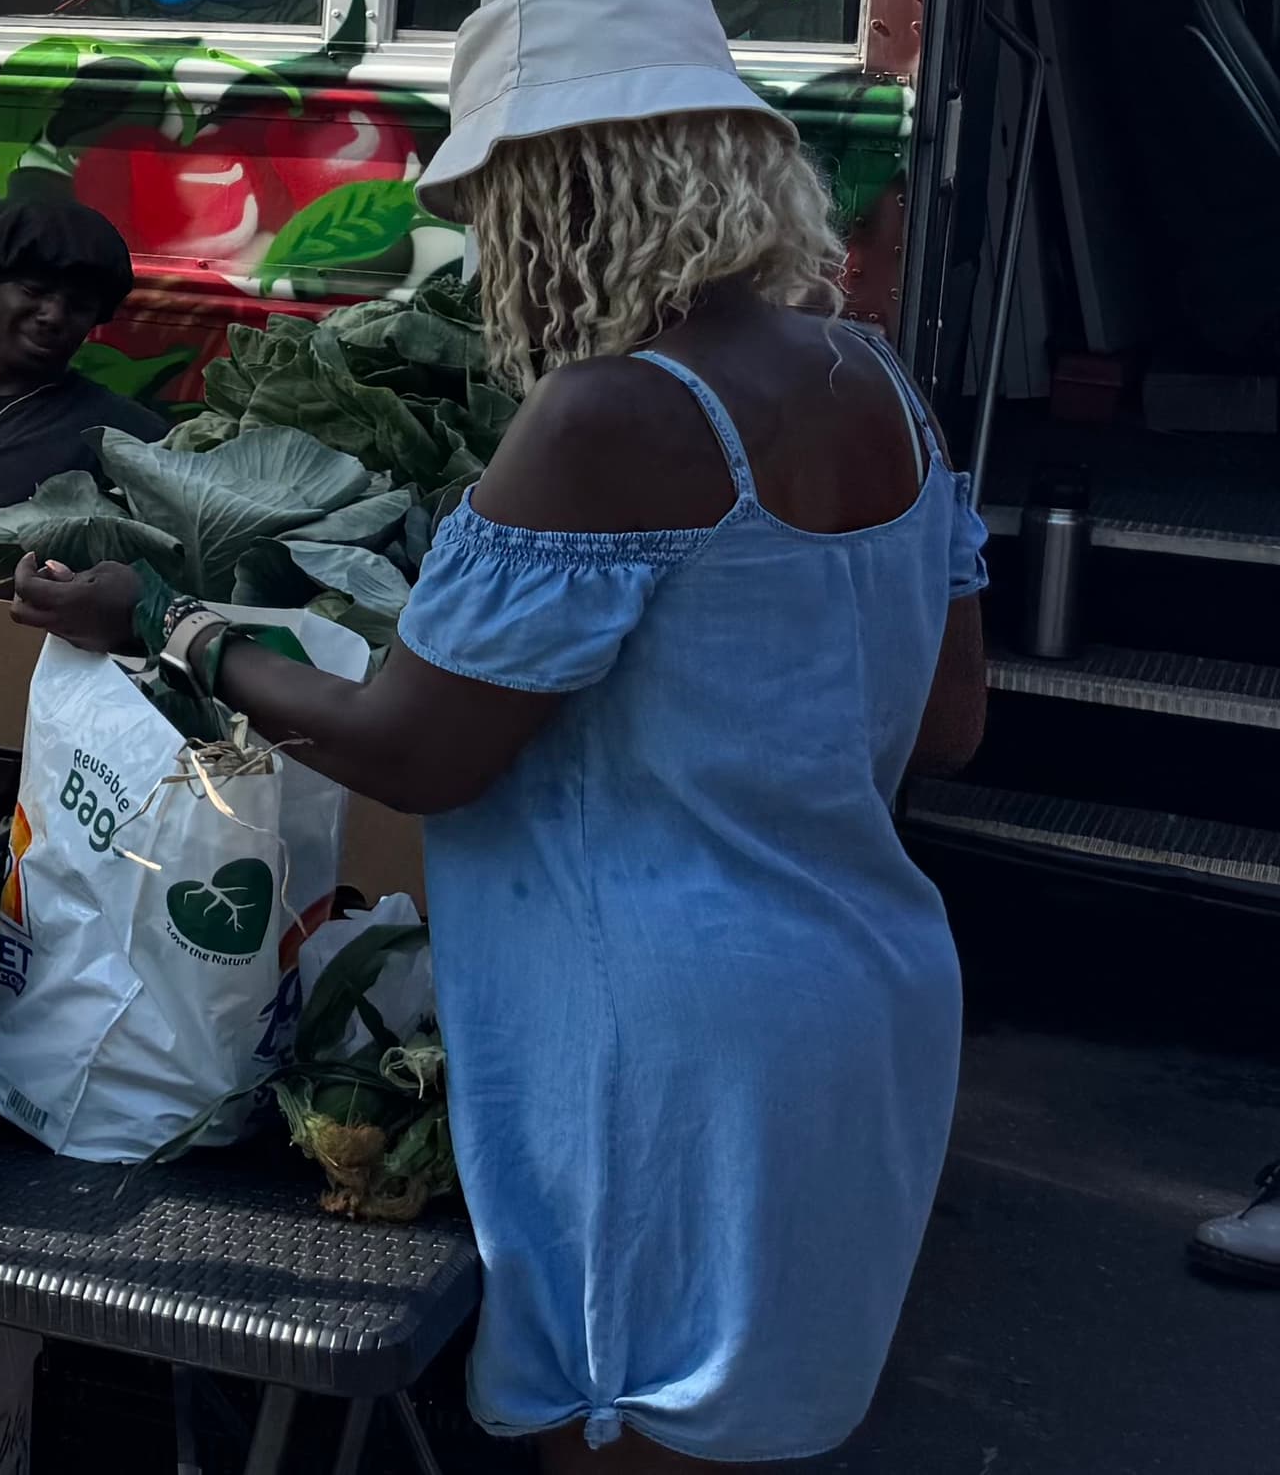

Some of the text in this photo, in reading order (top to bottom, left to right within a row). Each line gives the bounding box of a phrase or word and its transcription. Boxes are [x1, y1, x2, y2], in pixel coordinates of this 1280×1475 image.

[59, 768, 116, 853] Bag
[73, 748, 130, 814] Reusable
[188, 944, 209, 963] the
